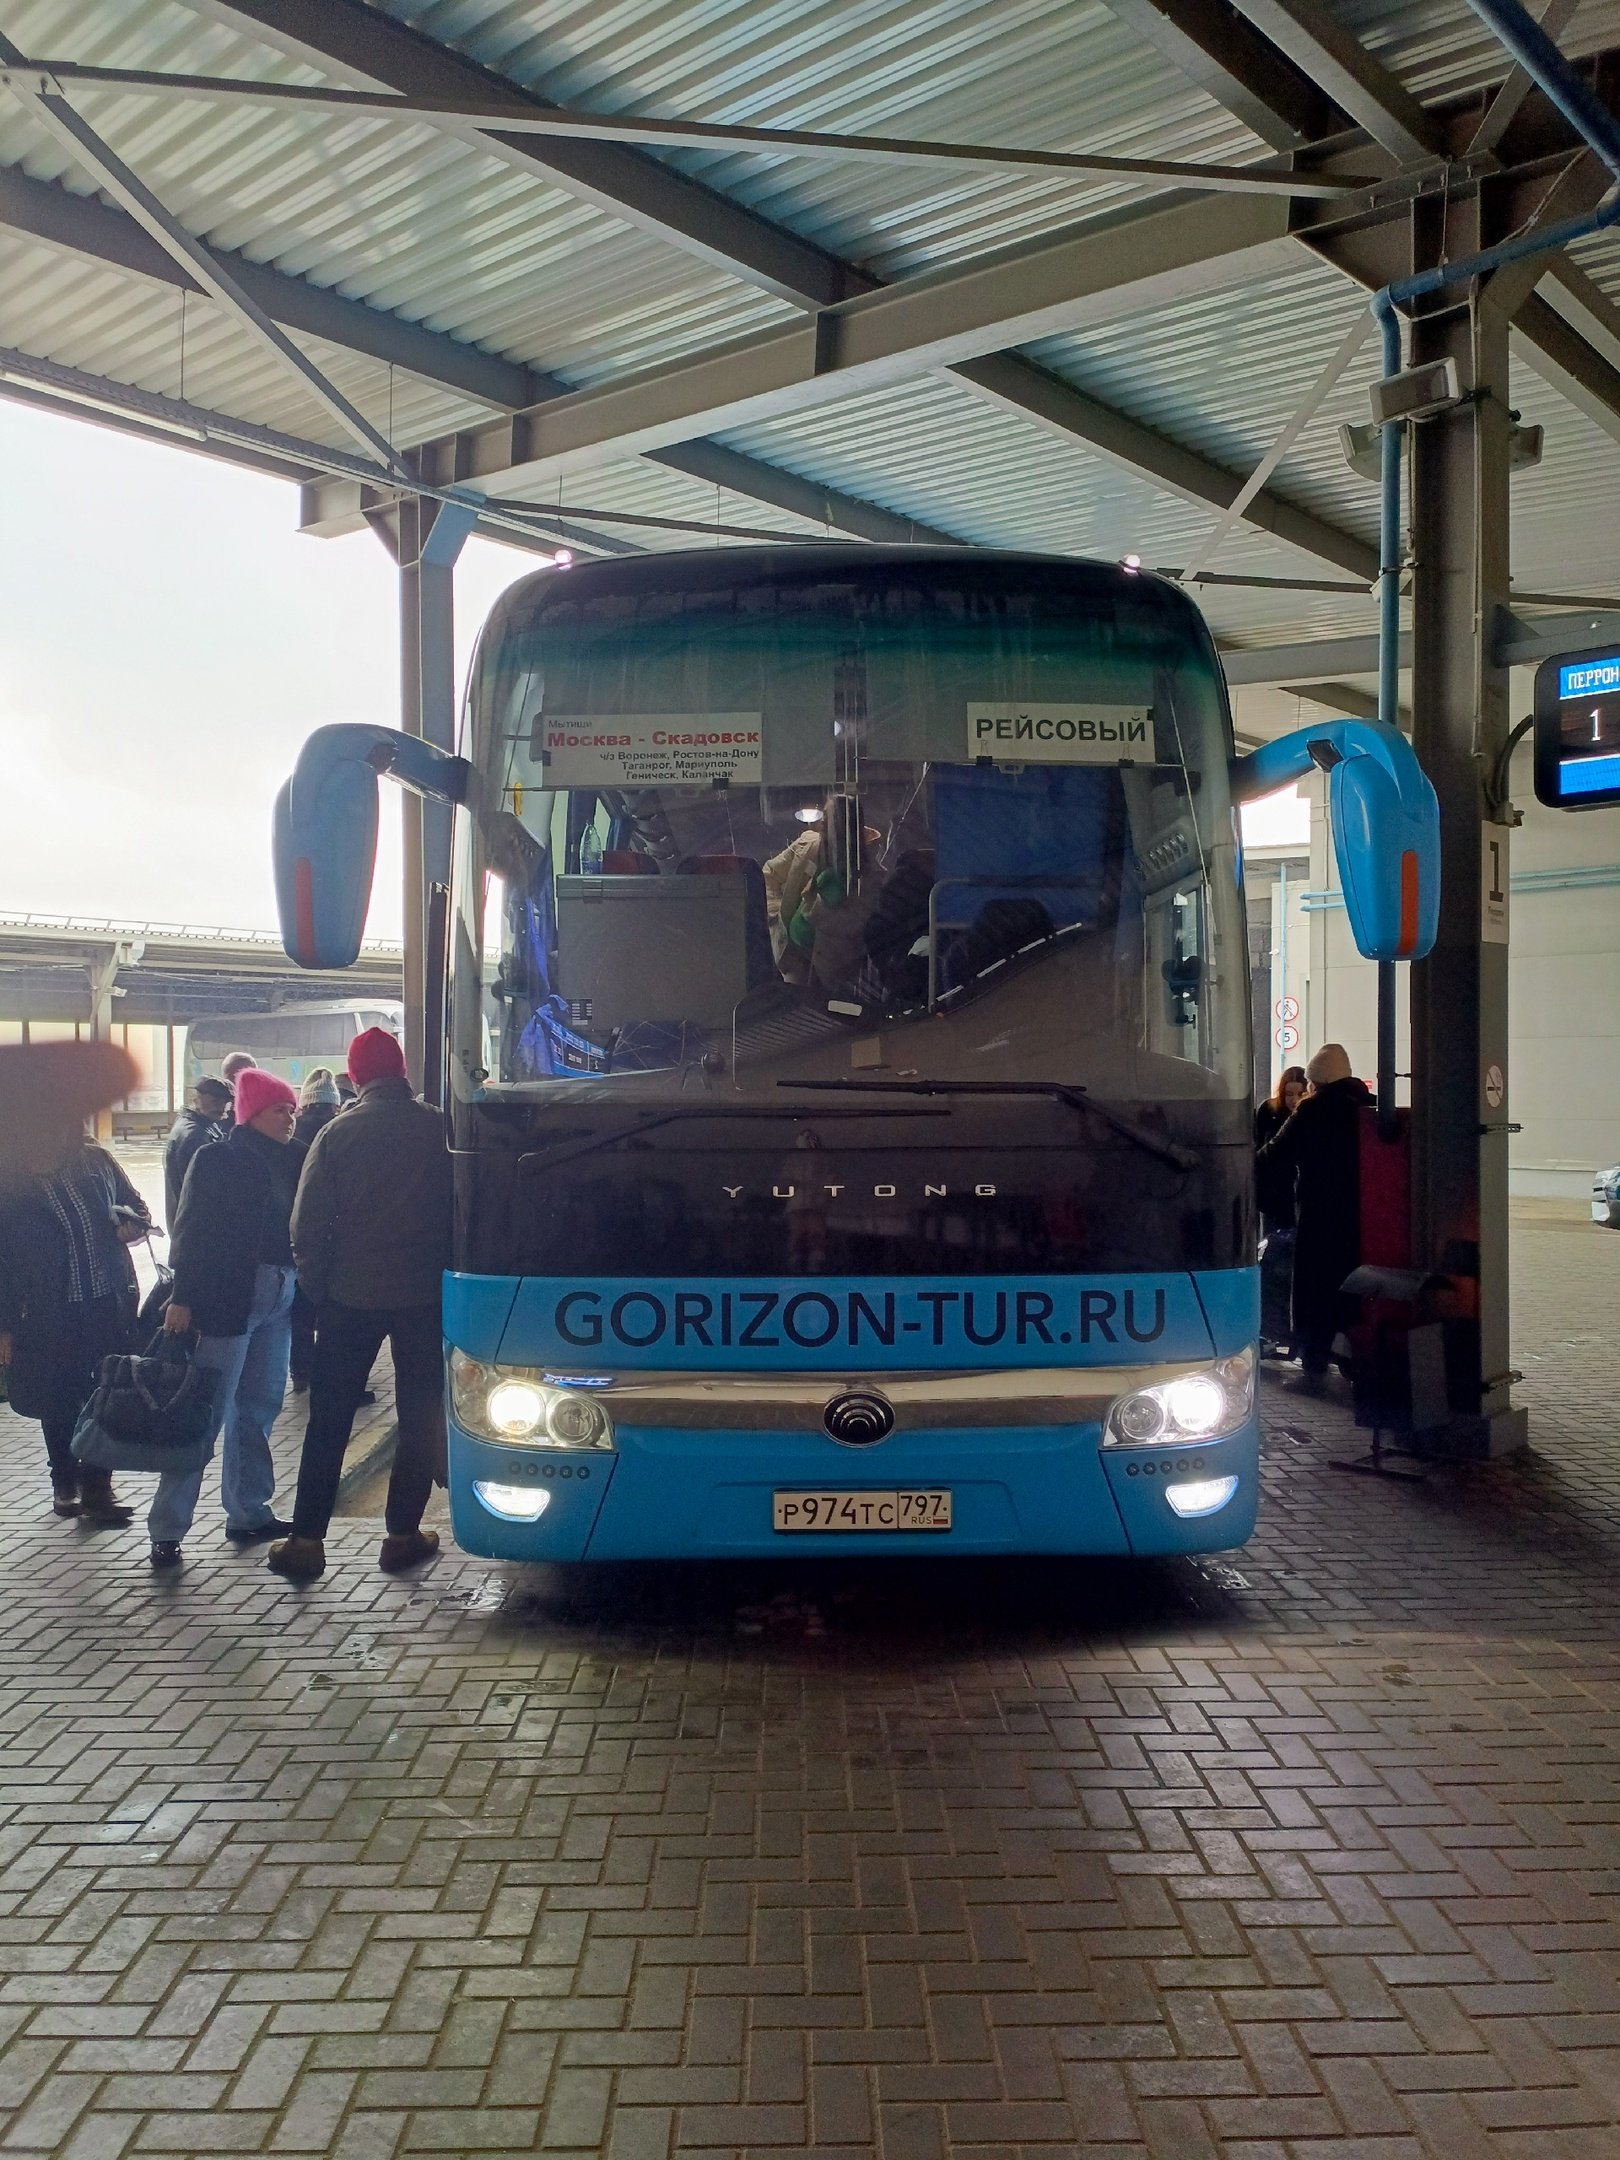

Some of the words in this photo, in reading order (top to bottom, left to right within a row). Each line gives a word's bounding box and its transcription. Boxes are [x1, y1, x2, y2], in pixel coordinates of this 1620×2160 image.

[1568, 666, 1619, 690] ПЕРРОН
[976, 714, 1146, 742] РЕЙСОВЫЙ
[1589, 708, 1601, 741] 1
[548, 732, 631, 747] Москва
[652, 731, 759, 746] Скадовск
[600, 752, 615, 761] ч/з
[618, 751, 670, 761] Воронеж,
[673, 749, 759, 759] Ростов-на-Дону
[675, 760, 738, 770] Мариуполь
[1489, 841, 1504, 902] 1
[1284, 1033, 1290, 1042] 5
[722, 1184, 997, 1198] YUTONG
[554, 1288, 1166, 1348] GORIZON-TUR.RU
[784, 1497, 894, 1525] Р974ТС
[900, 1495, 943, 1517] 797
[911, 1516, 932, 1525] RUS
